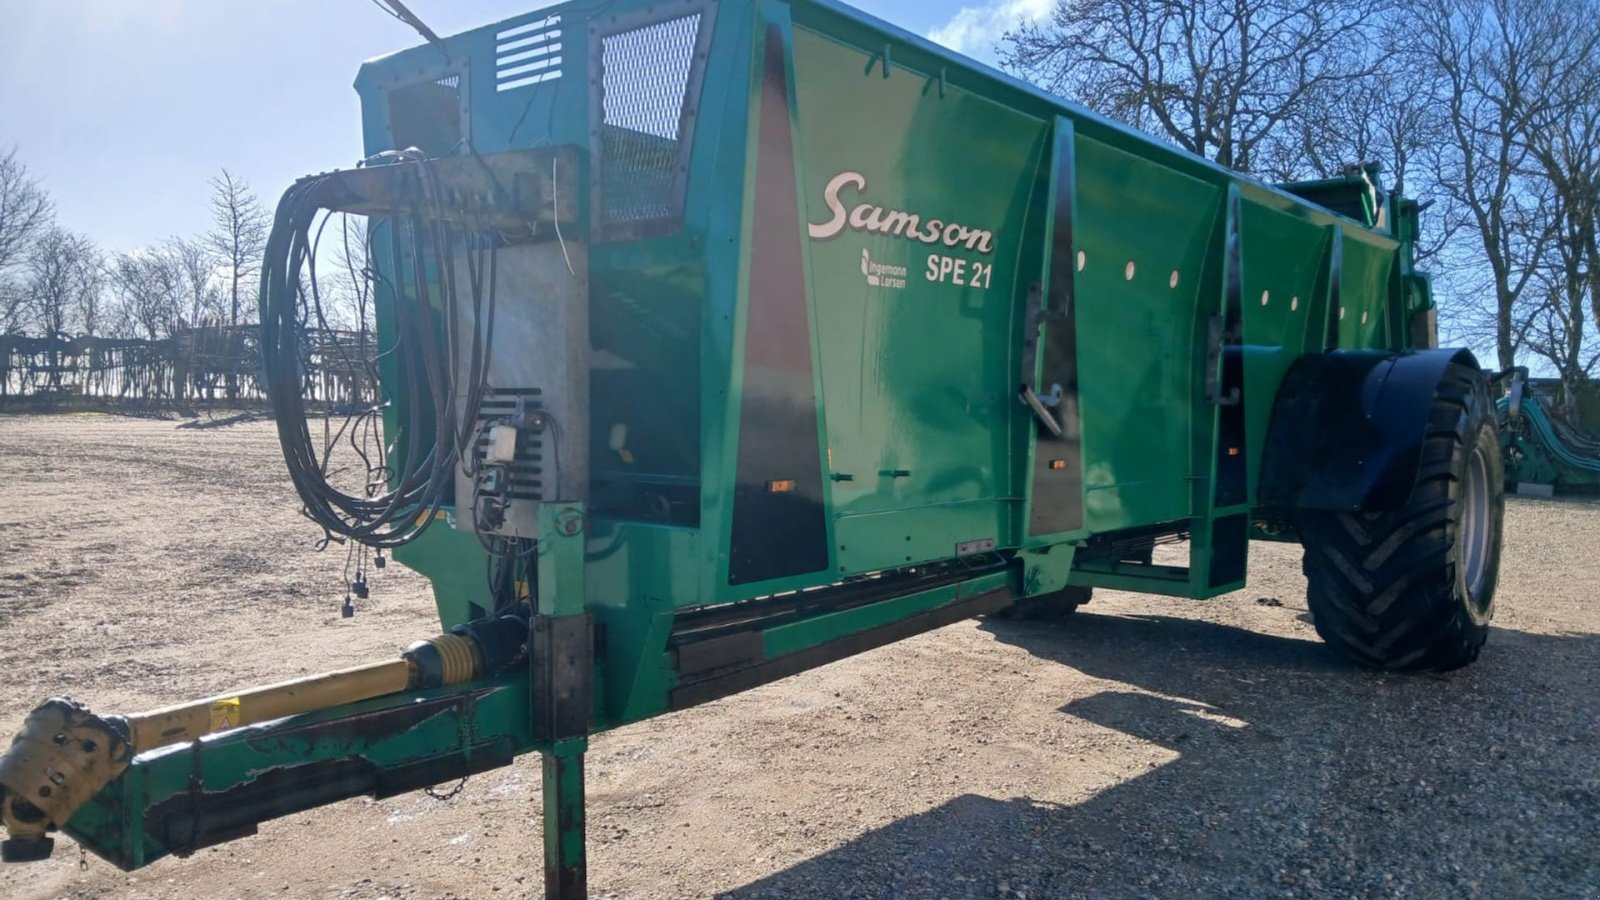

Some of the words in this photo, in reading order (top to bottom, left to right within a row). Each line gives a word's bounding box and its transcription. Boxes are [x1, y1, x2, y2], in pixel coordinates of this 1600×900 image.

[808, 171, 993, 253] Samson
[869, 261, 907, 276] Ingemann
[925, 254, 967, 285] SPE
[970, 262, 992, 289] 21
[880, 276, 906, 288] Larsen
